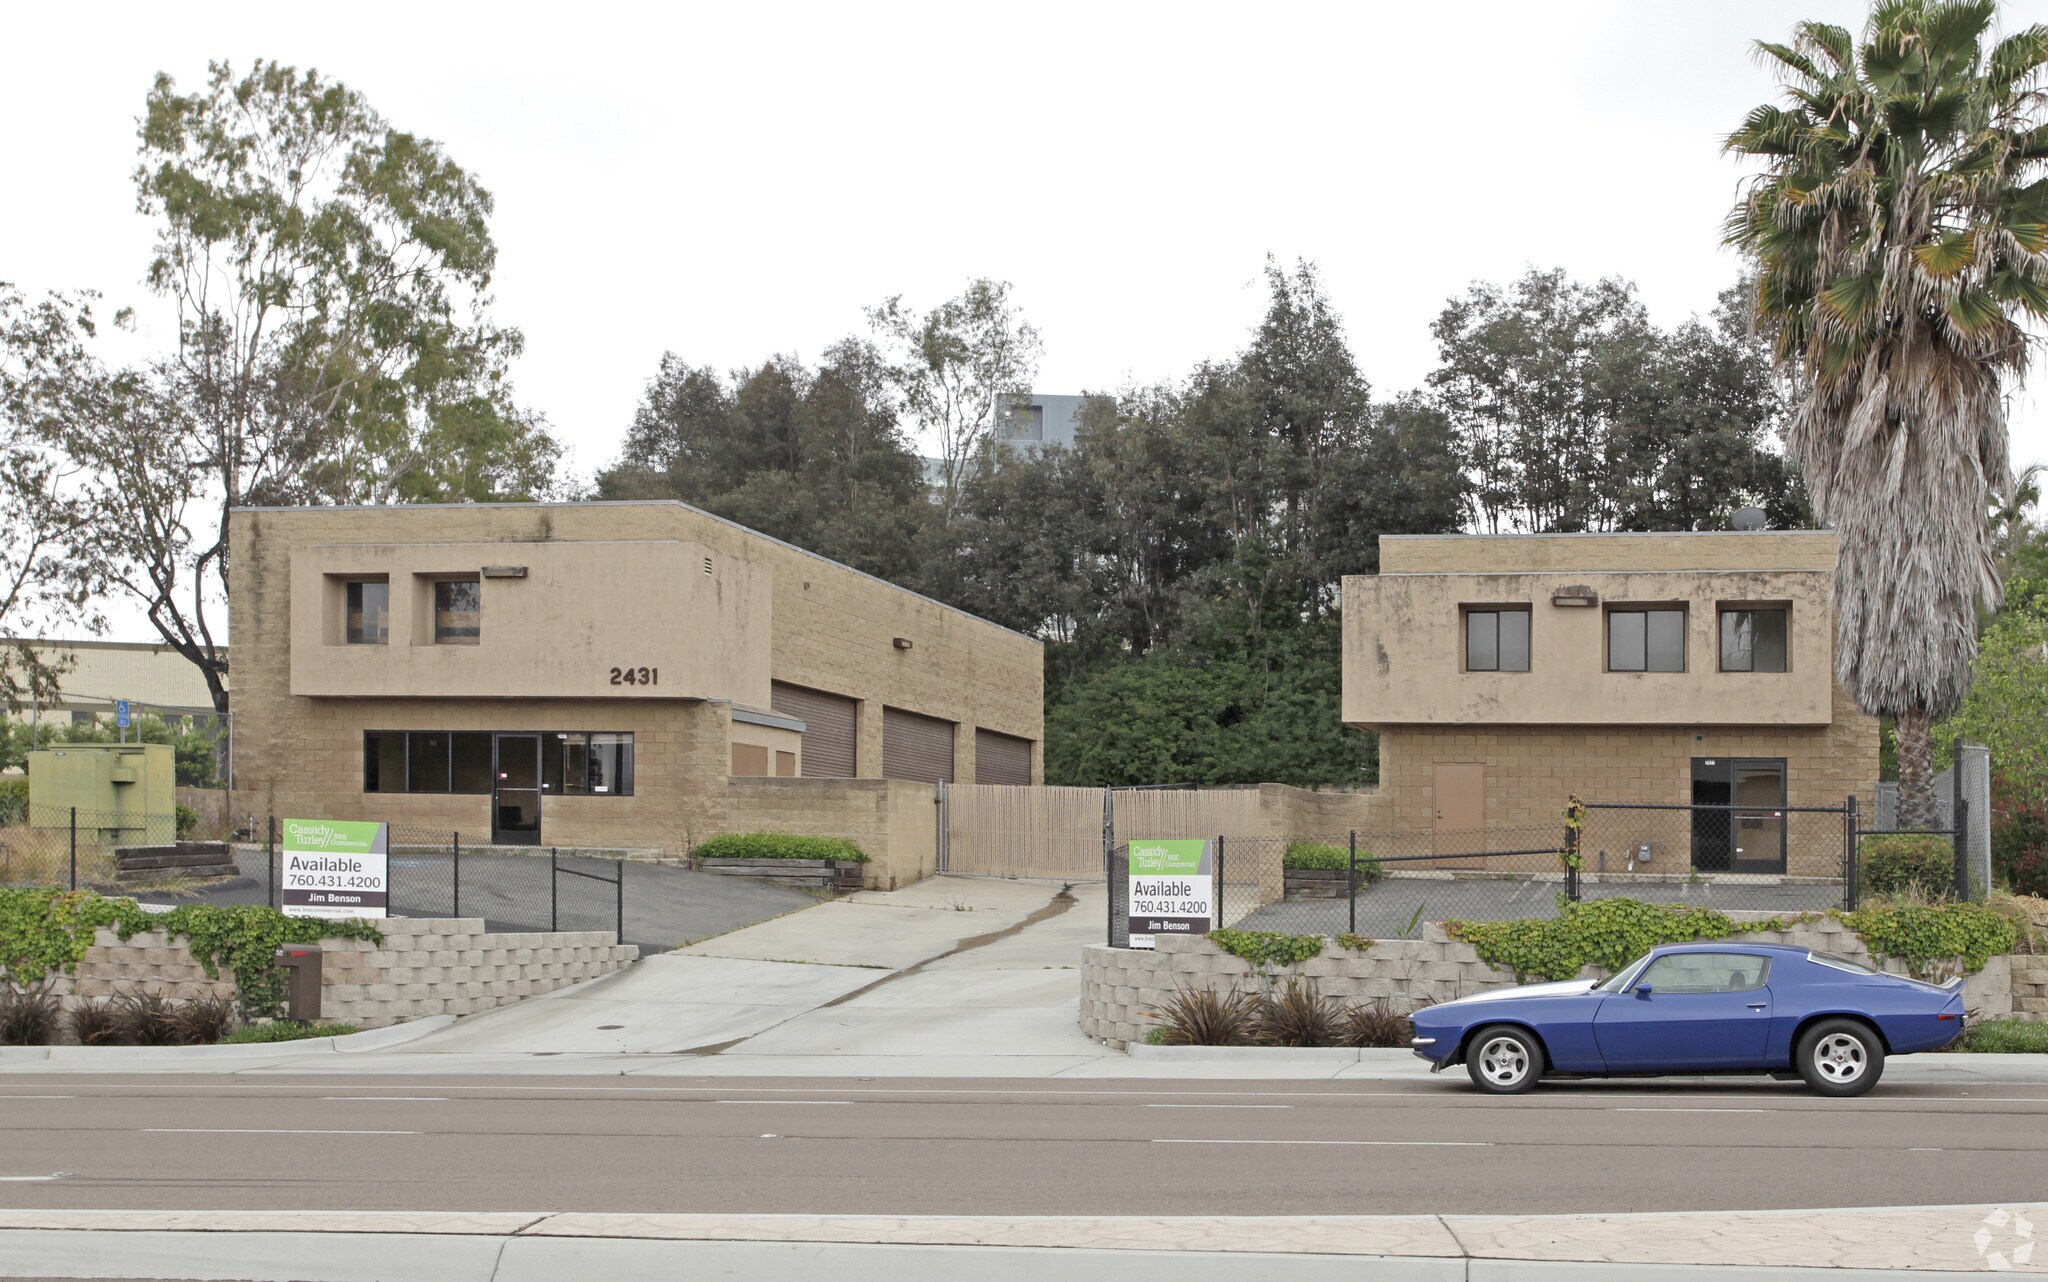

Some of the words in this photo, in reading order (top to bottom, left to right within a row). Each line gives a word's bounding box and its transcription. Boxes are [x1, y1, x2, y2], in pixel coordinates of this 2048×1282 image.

[610, 667, 658, 686] 2431
[289, 824, 330, 838] Cassidy
[294, 834, 327, 848] Turley
[1133, 846, 1166, 860] Cassidy
[289, 856, 362, 873] Available
[1137, 856, 1163, 871] Turley
[289, 874, 381, 889] 760.431.4200
[1134, 880, 1192, 897] Available
[308, 893, 325, 902] Jim
[327, 893, 361, 903] Benson
[1134, 901, 1207, 914] 760.431.4200
[1147, 921, 1161, 930] Jim
[1163, 921, 1190, 931] Benson
